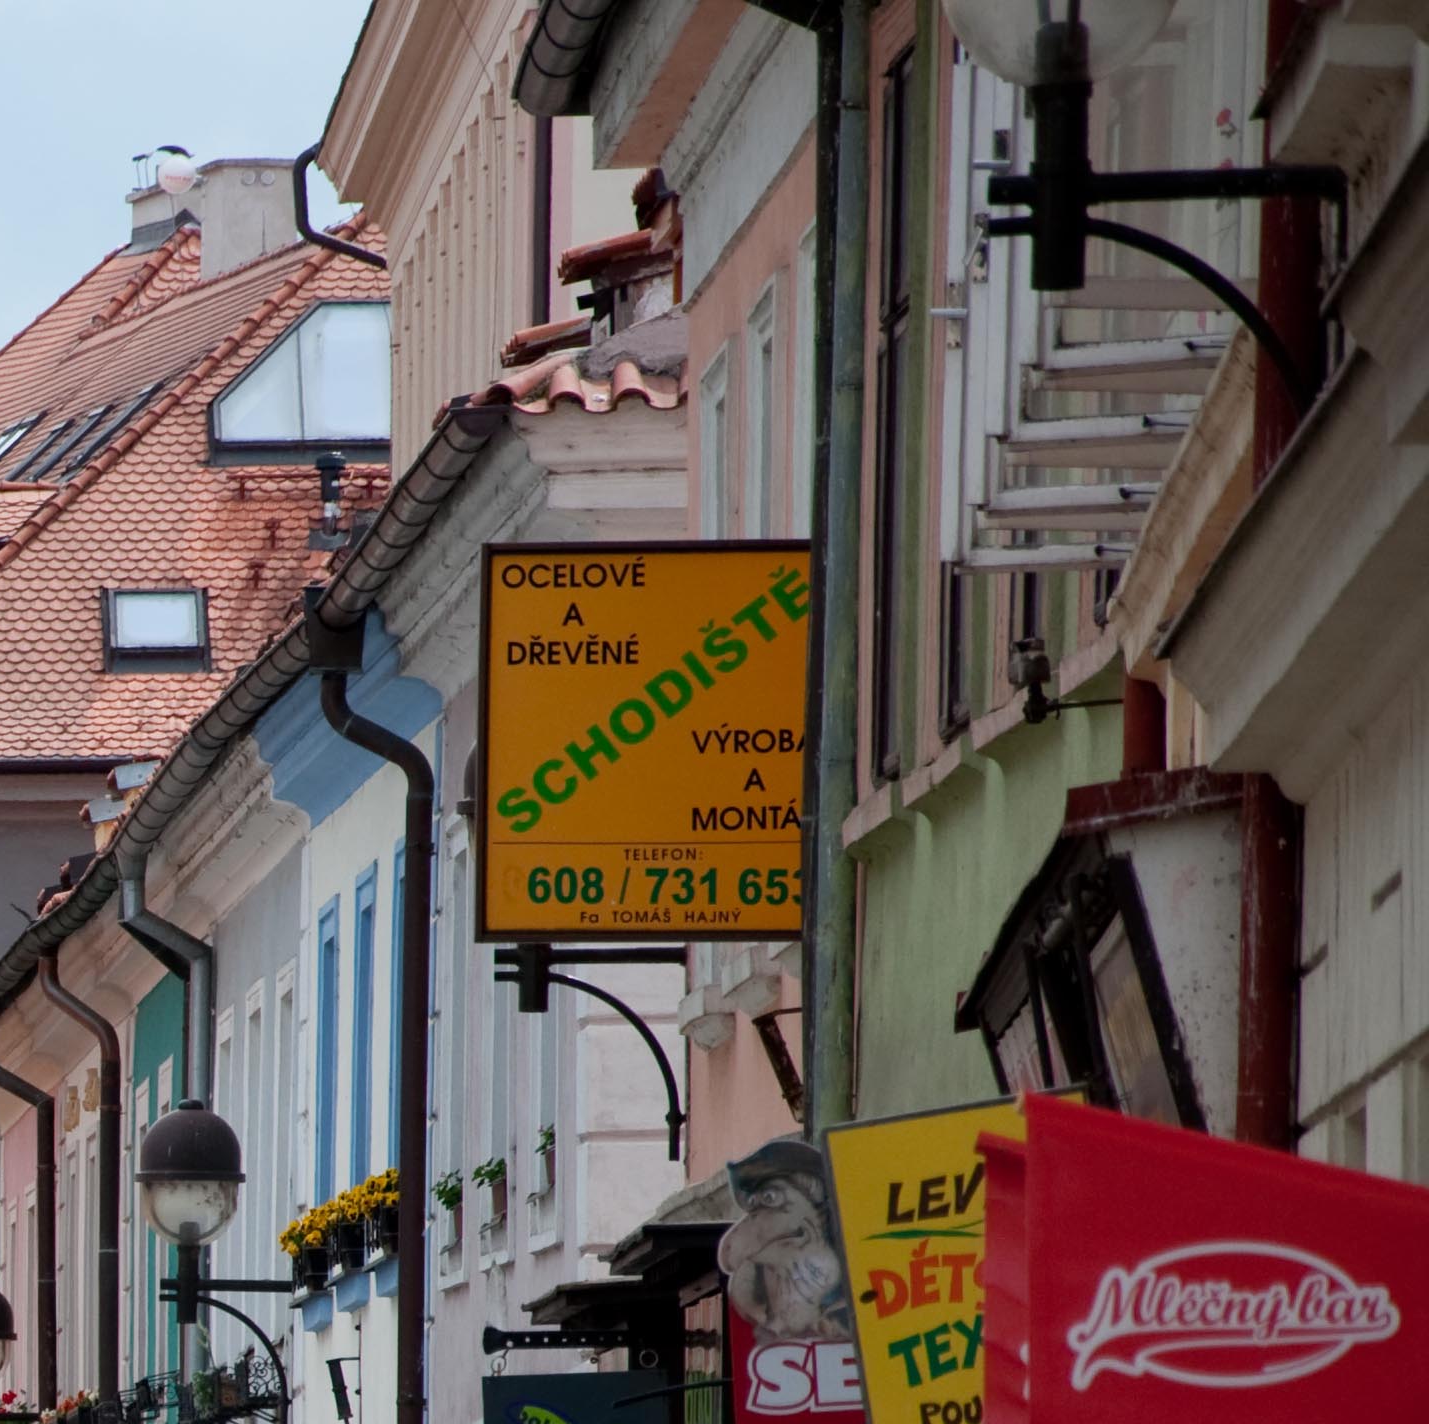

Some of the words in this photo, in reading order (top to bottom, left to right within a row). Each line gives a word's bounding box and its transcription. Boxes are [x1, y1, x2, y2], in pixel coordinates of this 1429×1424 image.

[502, 557, 646, 589] OCELOVÉ
[563, 603, 584, 626] A
[508, 634, 639, 665] DŘEVĚNÉ
[496, 564, 810, 833] SCHODIŠTĚ
[744, 768, 764, 791] A
[691, 799, 801, 831] MONTÁ
[623, 848, 704, 861] TELEFON:
[528, 867, 605, 904] 608
[644, 868, 718, 904] 731
[580, 911, 599, 924] Fa
[611, 907, 671, 924] TOMÁŠ
[685, 907, 742, 924] HAJNÝ
[887, 1163, 985, 1225] LEV
[1073, 1272, 1288, 1342] Mléčný
[1296, 1275, 1395, 1332] bar
[888, 1313, 985, 1387] TEX
